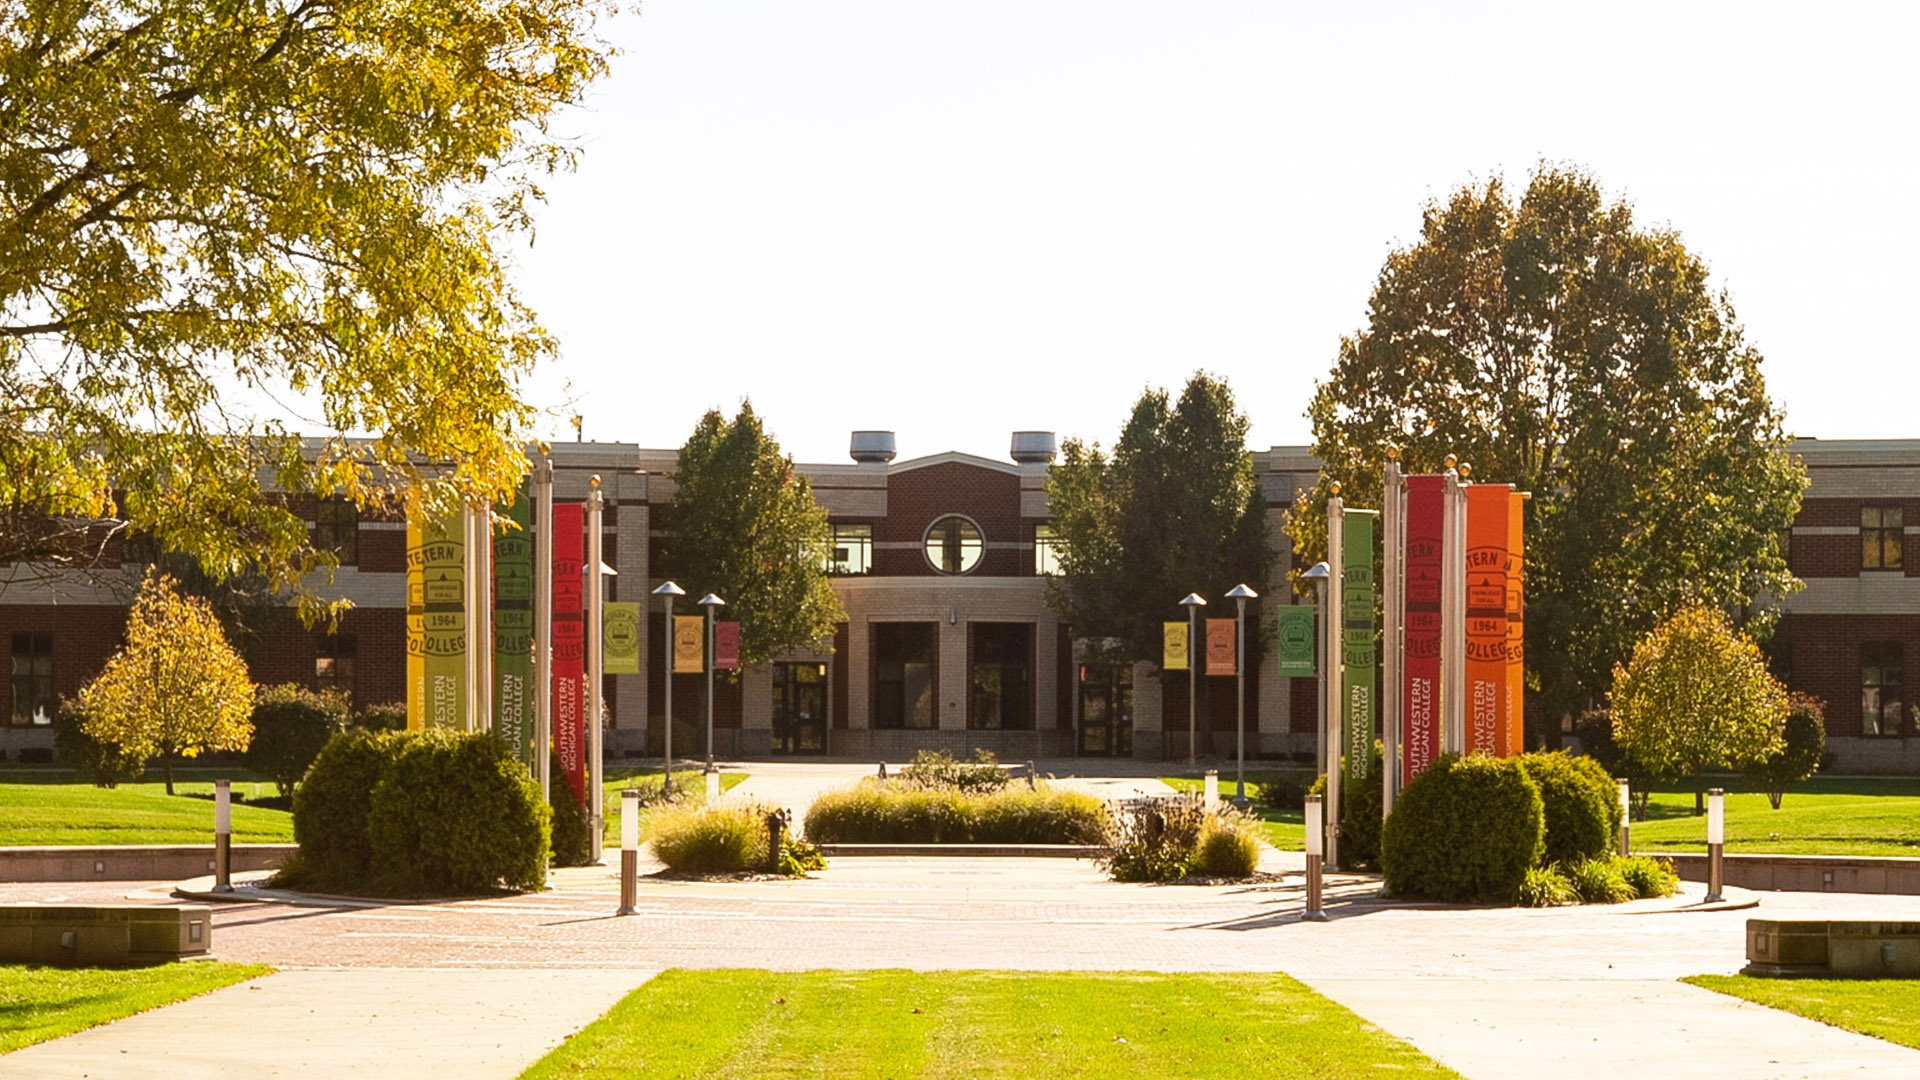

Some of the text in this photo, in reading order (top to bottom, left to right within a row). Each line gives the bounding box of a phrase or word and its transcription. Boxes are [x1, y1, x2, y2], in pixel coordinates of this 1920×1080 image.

[423, 546, 454, 563] TERN
[1466, 552, 1498, 568] TERN
[432, 615, 456, 626] 1964
[503, 613, 524, 624] 1964
[1473, 621, 1497, 631] 1964
[424, 634, 465, 653] OLLEG
[496, 634, 531, 652] OLLEG
[1466, 640, 1506, 658] OLLEG
[446, 676, 457, 724] COLLEGE
[513, 675, 524, 724] COLLEGE
[1421, 678, 1431, 728] COLLEGE
[1473, 680, 1485, 751] HWESTERN
[1485, 681, 1496, 729] COLLEGE
[558, 677, 570, 771] SOUTHWESTERN
[567, 678, 577, 771] MICHIGAN COLLEGE
[1351, 685, 1361, 780] SOUTHWESTERN
[1360, 686, 1369, 780] MICHIGAN COLLEGE
[1410, 677, 1422, 779] OUTHWESTERN
